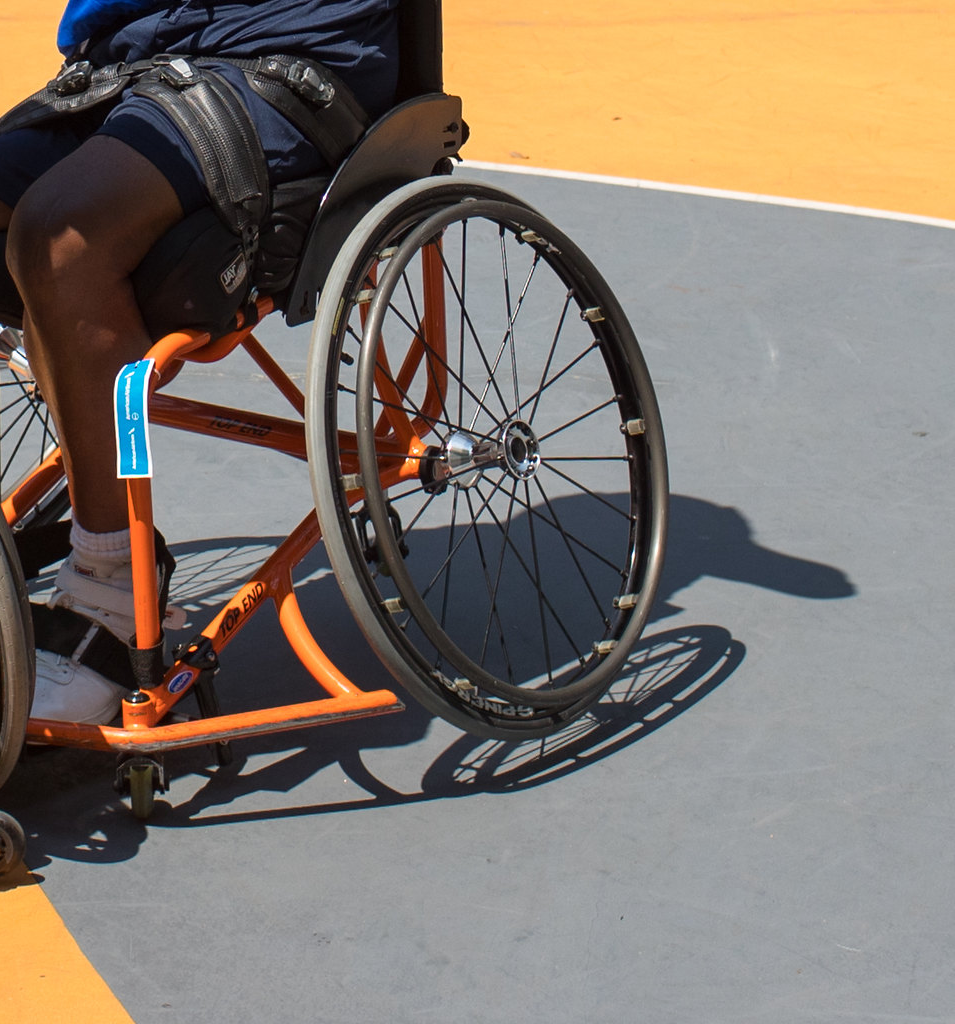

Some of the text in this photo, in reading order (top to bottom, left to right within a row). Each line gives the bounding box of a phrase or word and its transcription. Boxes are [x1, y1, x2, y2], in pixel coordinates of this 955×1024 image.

[223, 264, 237, 286] JAY
[209, 416, 273, 437] TOP END
[219, 582, 264, 638] TOP END
